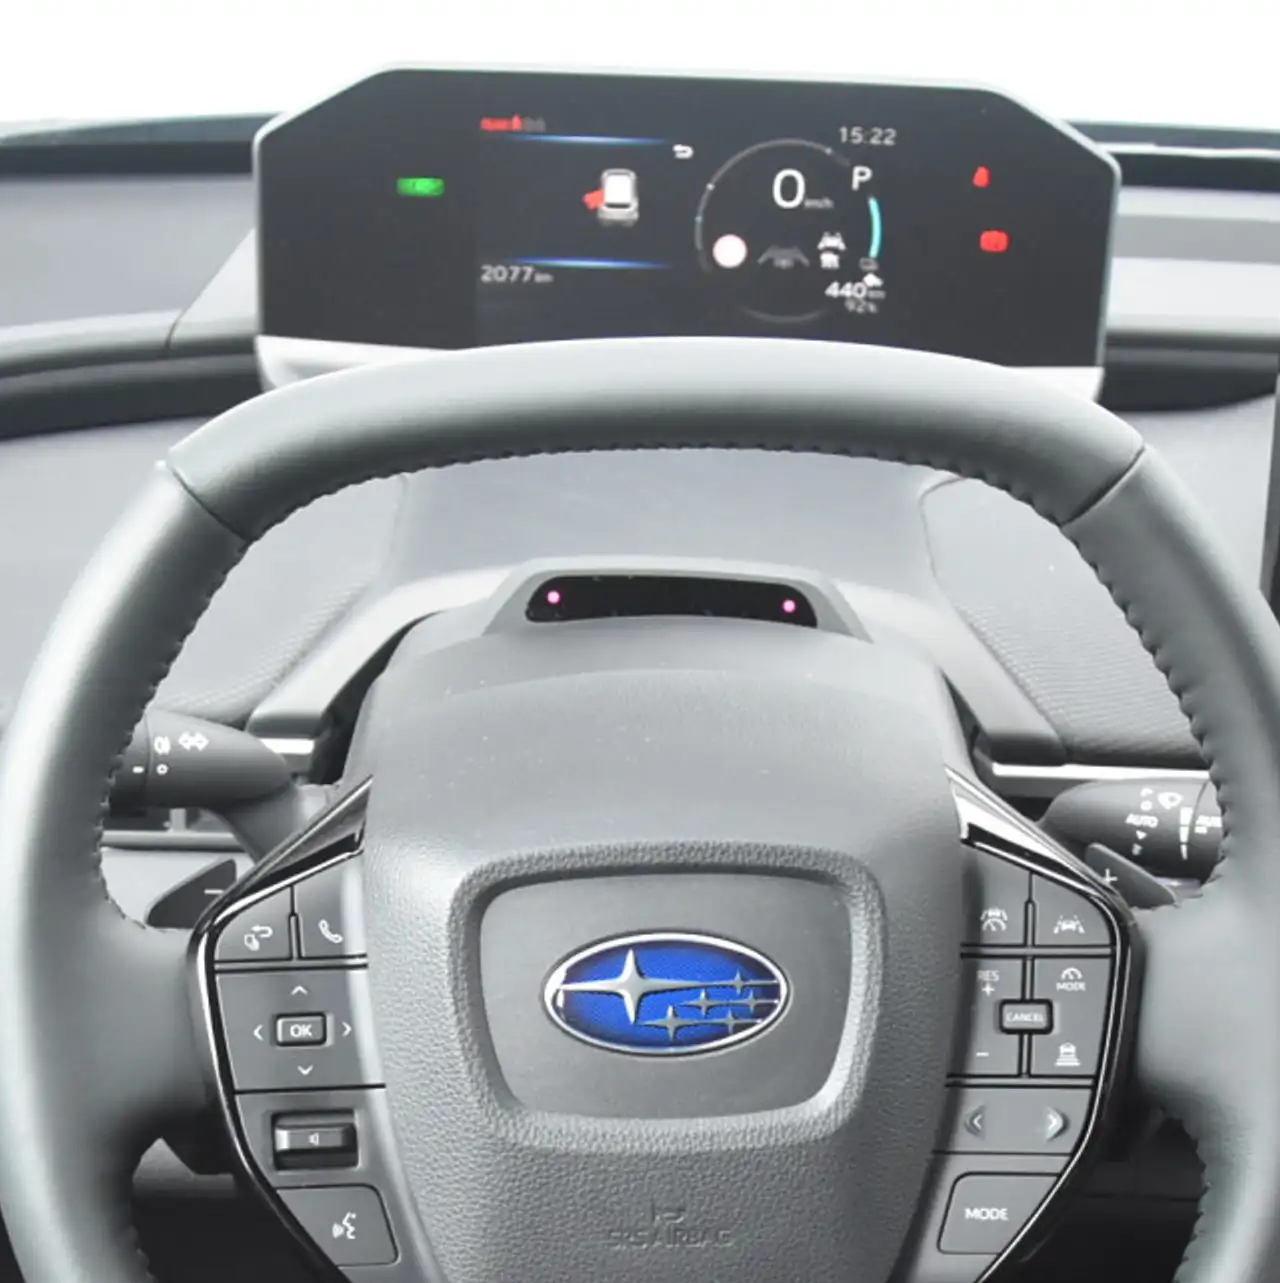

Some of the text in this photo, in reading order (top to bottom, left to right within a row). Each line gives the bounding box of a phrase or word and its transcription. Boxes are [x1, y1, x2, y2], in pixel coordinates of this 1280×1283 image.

[839, 126, 897, 146] 15:22
[852, 166, 872, 190] P
[773, 168, 805, 209] 0
[480, 265, 533, 283] 2077
[825, 281, 867, 298] 440
[1125, 813, 1159, 829] AUTO
[977, 969, 1000, 982] RES
[1056, 981, 1087, 992] MODE
[1005, 1011, 1045, 1022] CANCEL
[289, 1023, 313, 1038] OK
[964, 1207, 1010, 1221] MODE
